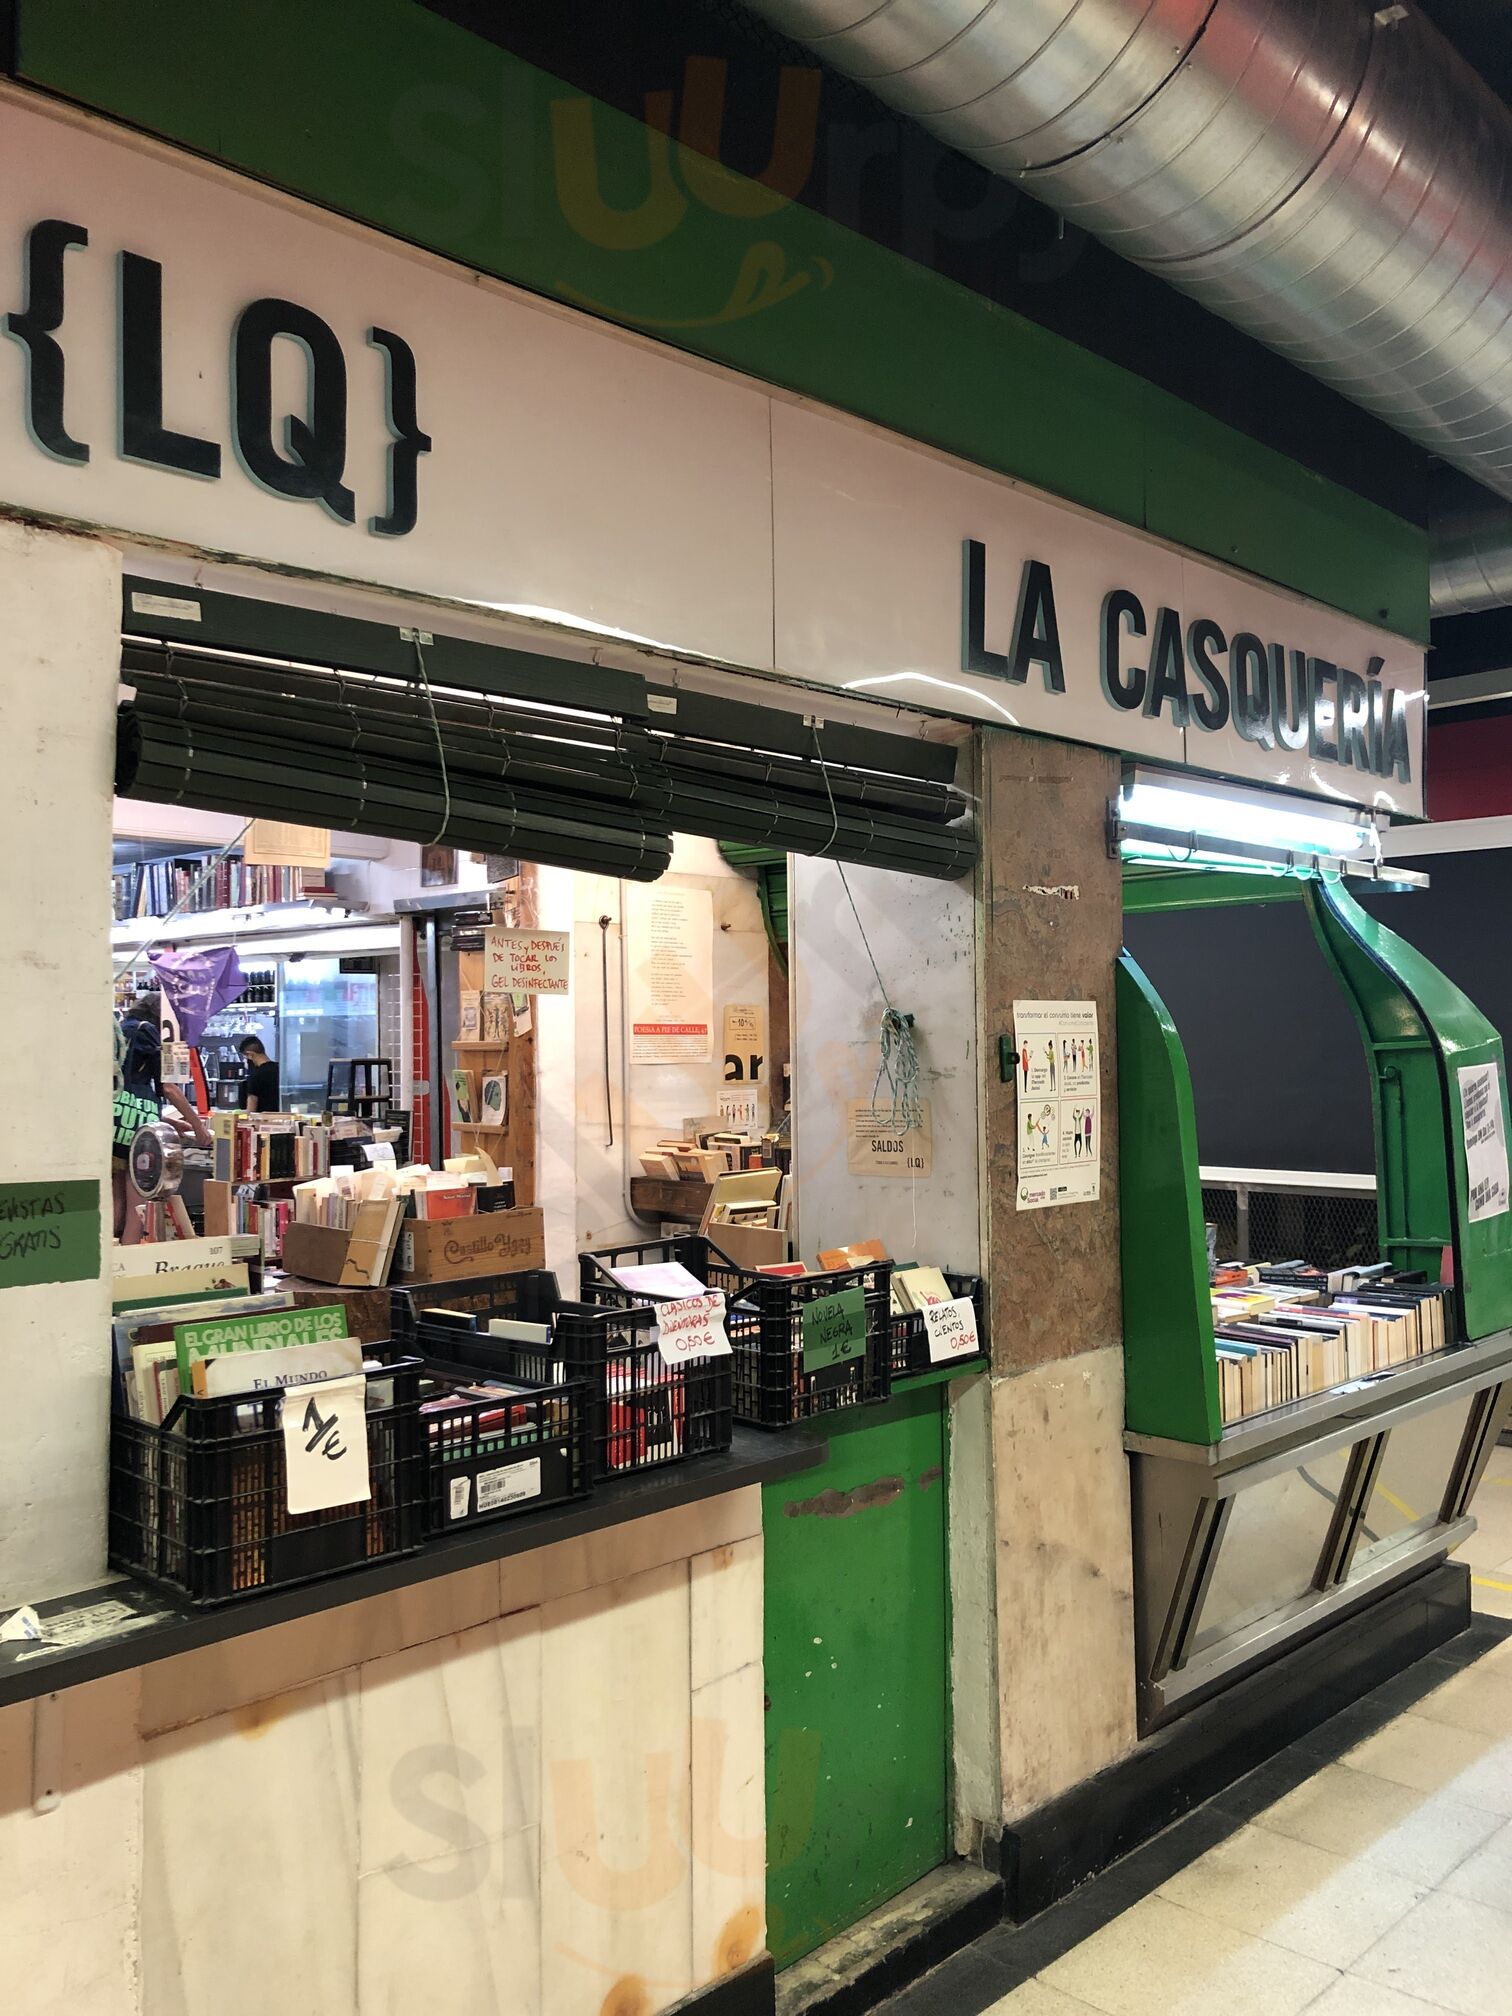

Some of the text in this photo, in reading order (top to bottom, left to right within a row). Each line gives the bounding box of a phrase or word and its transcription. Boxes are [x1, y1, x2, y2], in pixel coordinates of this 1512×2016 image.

[962, 539, 1412, 784] LA CASQUERÍA
[491, 936, 522, 951] ANTES
[531, 937, 564, 952] DESPUÉS
[493, 953, 504, 963] DE
[510, 953, 538, 962] TOCAR
[492, 974, 508, 988] GEL
[872, 1140, 904, 1153] SALDOS
[811, 1303, 844, 1326] NOVELA
[184, 1312, 342, 1348] EL GRAN LIBRO DE LOS
[820, 1320, 853, 1344] NEGRA
